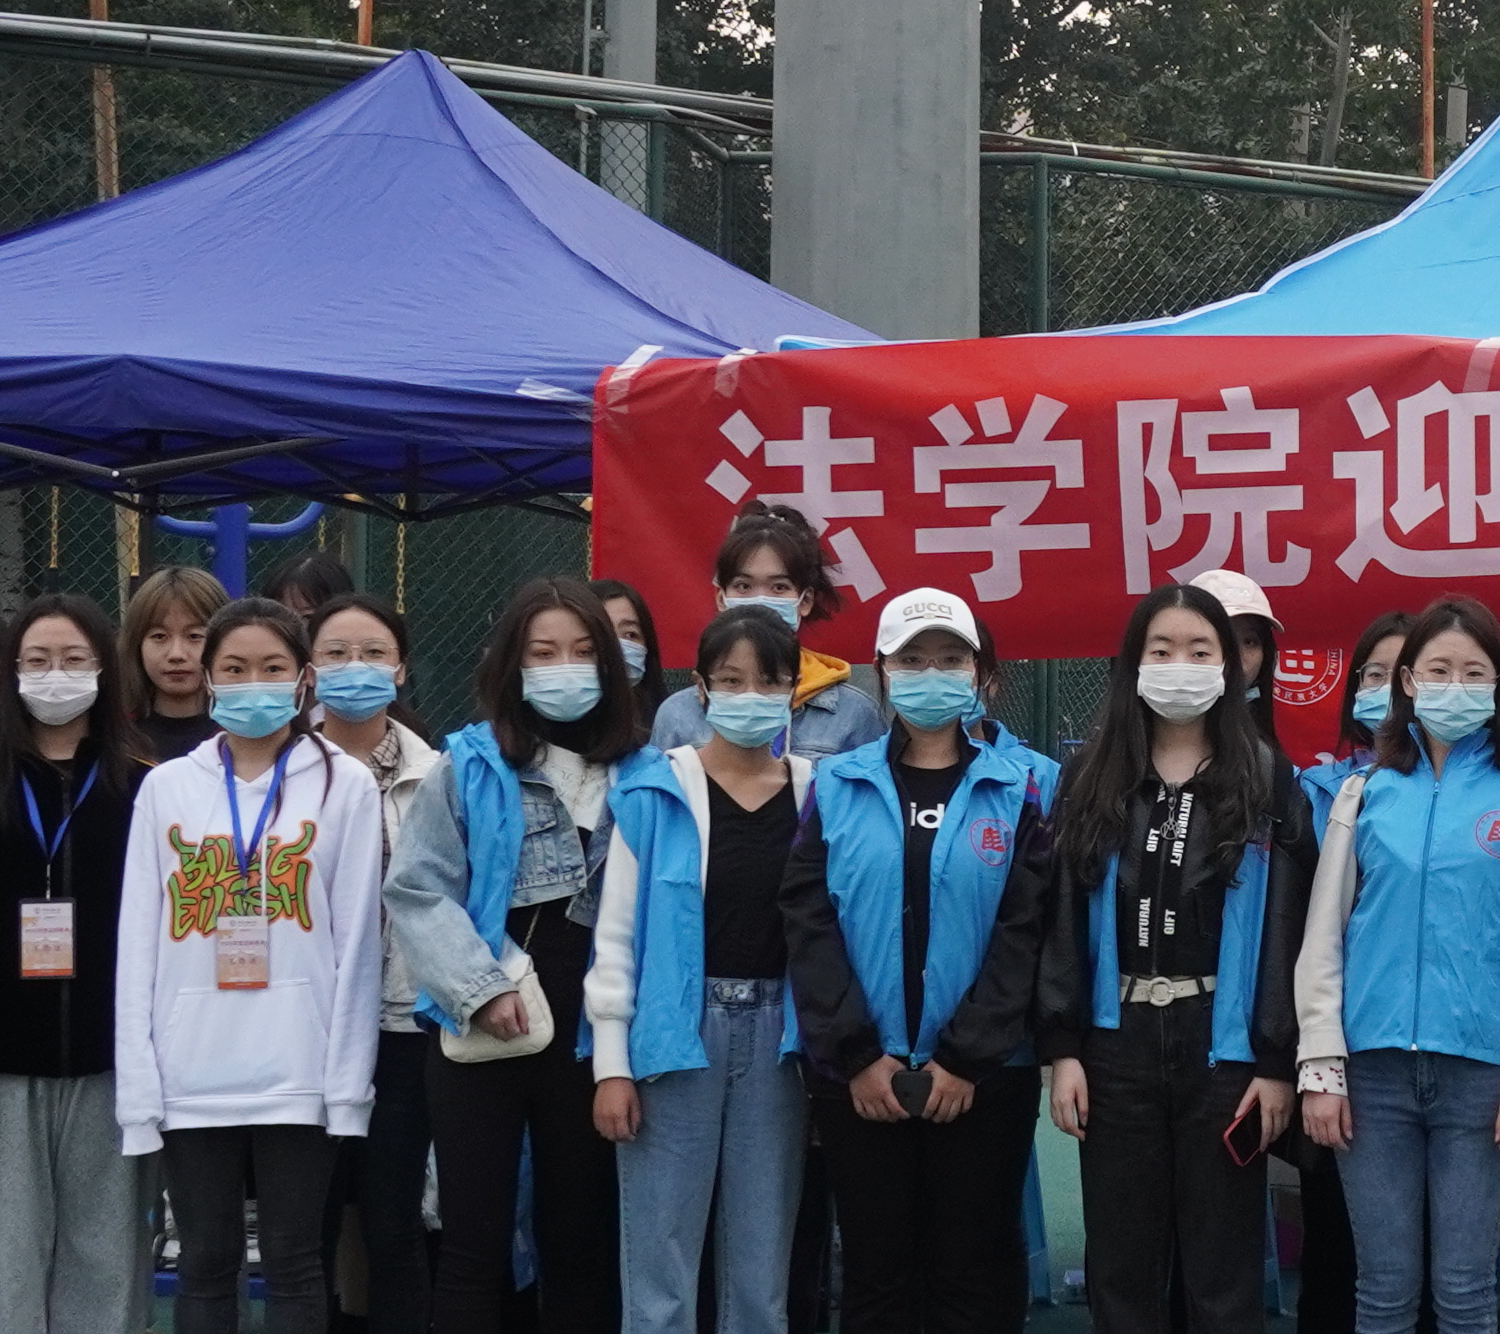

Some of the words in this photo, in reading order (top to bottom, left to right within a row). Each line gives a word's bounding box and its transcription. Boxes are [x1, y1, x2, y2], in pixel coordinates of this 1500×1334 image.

[902, 602, 954, 616] GUCCI
[1146, 828, 1160, 853] GIFT
[1171, 840, 1185, 867] GIFT
[1138, 897, 1151, 948] NATURAL
[1163, 908, 1176, 936] GIFT
